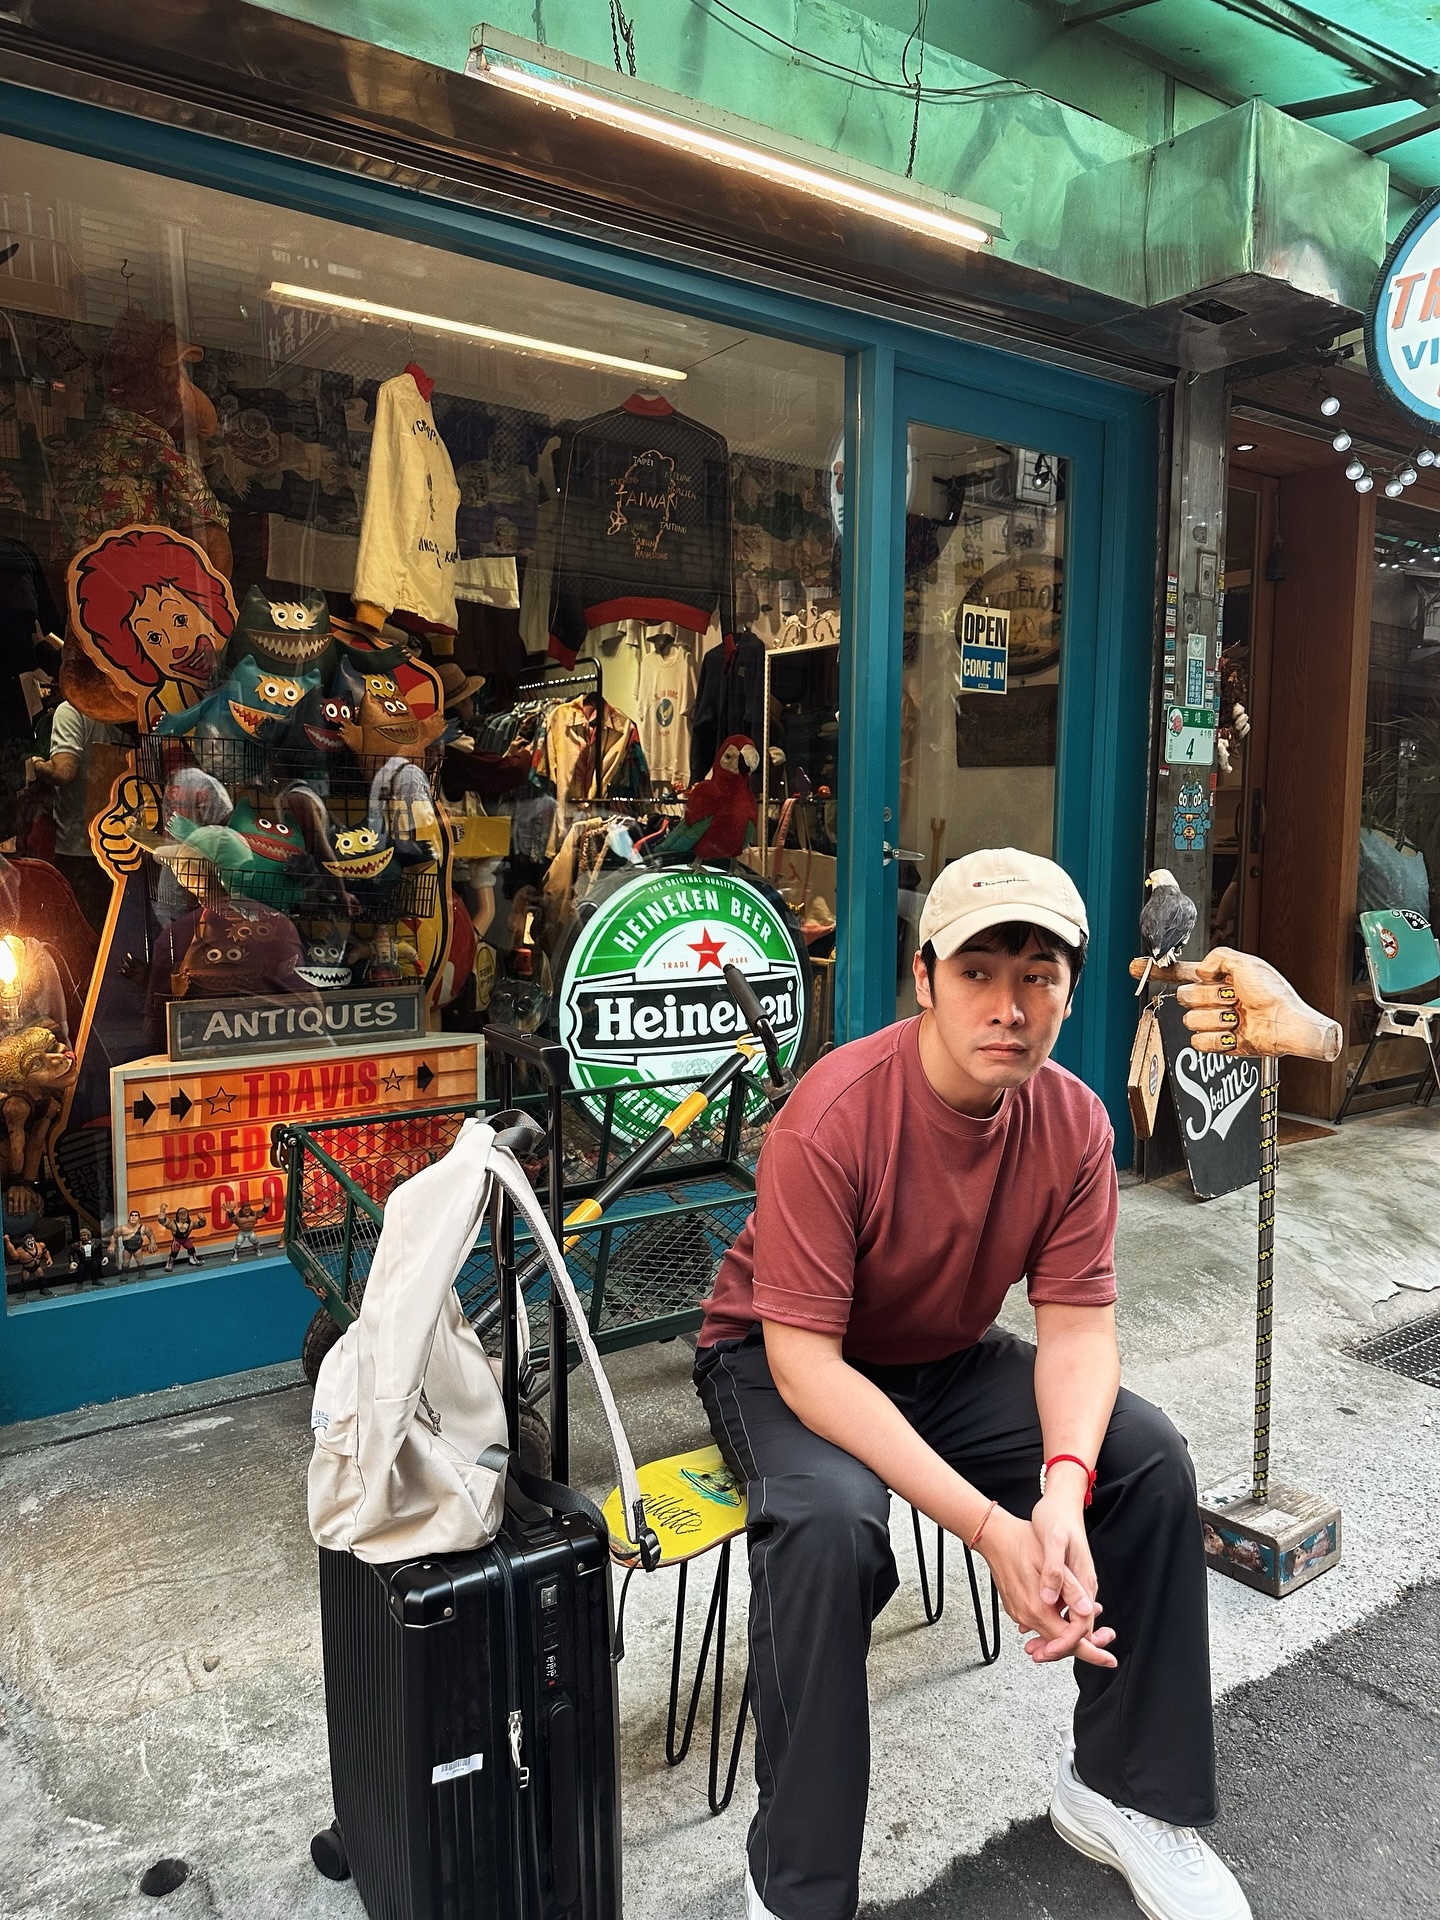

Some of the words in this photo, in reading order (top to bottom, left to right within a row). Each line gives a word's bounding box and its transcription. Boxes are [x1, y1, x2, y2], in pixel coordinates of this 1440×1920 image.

[615, 490, 678, 510] TAIWAN
[963, 612, 1008, 648] OPEN
[963, 657, 991, 679] COME
[993, 661, 1005, 680] IN
[1185, 738, 1195, 760] 4
[647, 883, 664, 894] THE
[665, 876, 703, 888] ORIGINAL
[704, 877, 736, 891] QUALITY
[613, 889, 719, 954] HEINEKEN
[730, 896, 772, 944] BEER
[663, 960, 689, 969] TRADE
[202, 1001, 398, 1042] ANTIQUES
[244, 1060, 378, 1119] TRAVIS
[1210, 1087, 1224, 1111] by
[1221, 1061, 1259, 1105] me
[162, 1125, 266, 1183] USED
